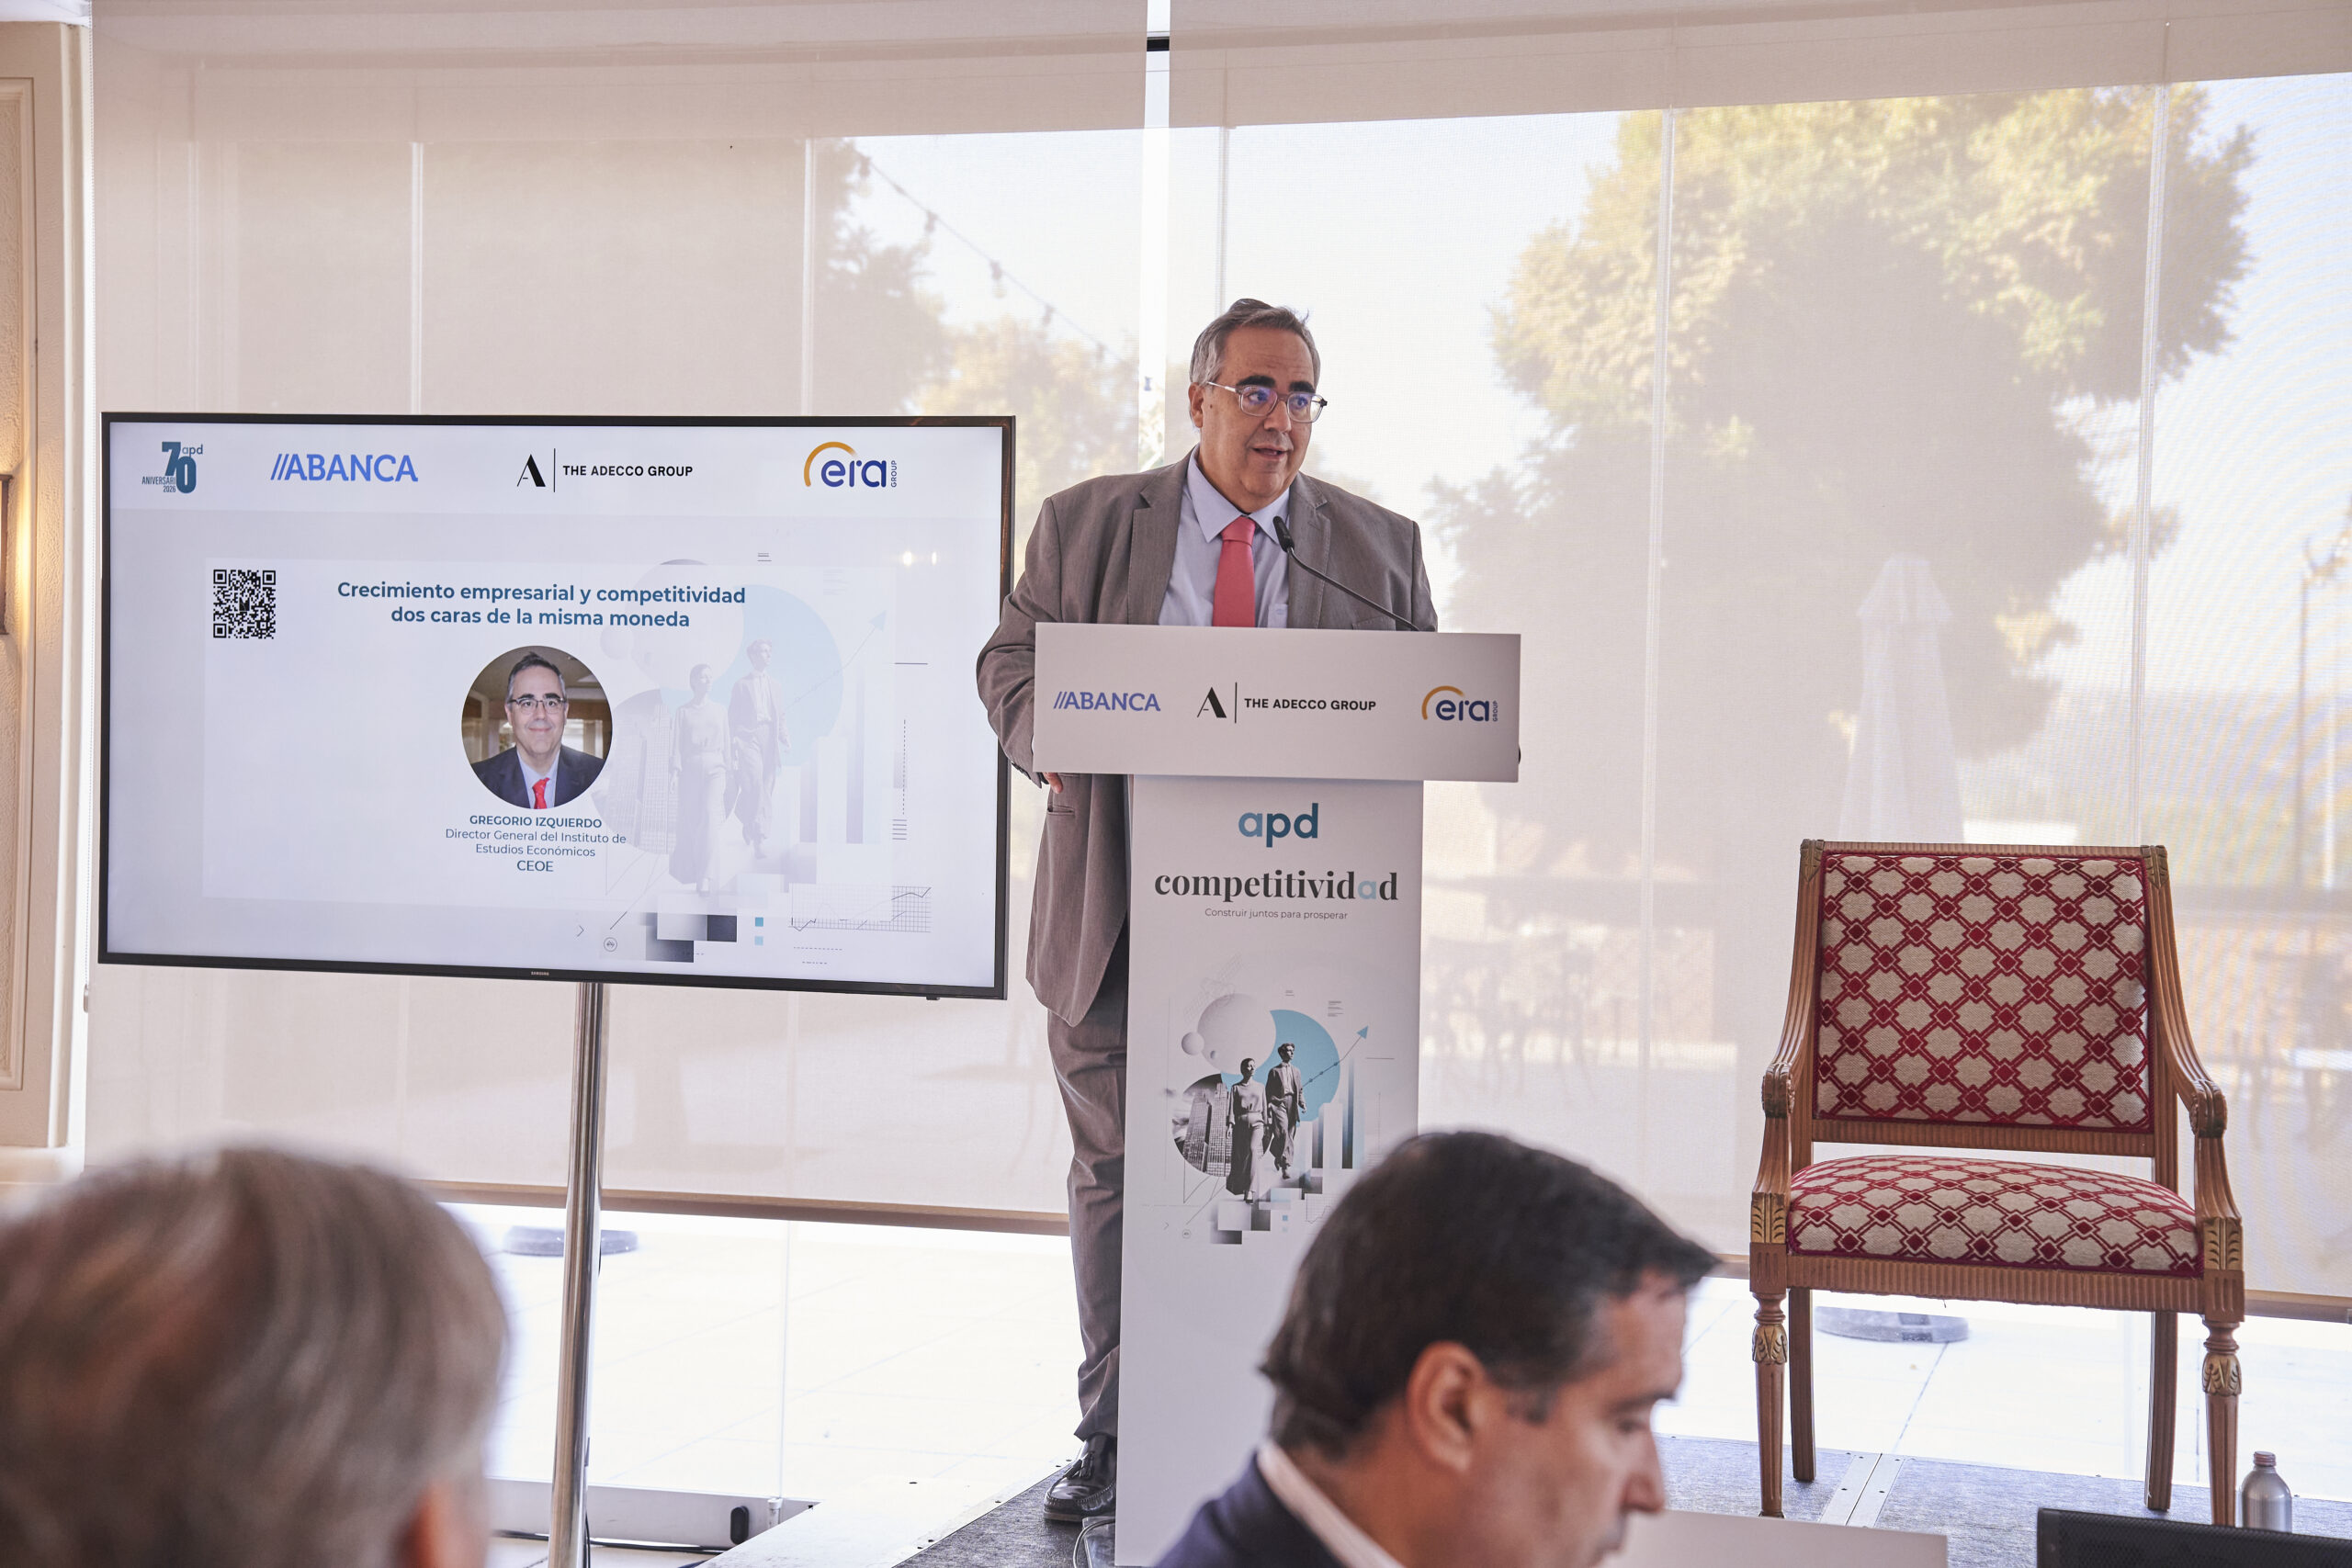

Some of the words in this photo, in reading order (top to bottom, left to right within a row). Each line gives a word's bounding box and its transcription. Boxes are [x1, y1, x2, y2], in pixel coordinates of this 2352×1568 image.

[182, 444, 203, 457] apd
[562, 465, 587, 476] THE
[590, 465, 644, 477] ADECCO
[647, 466, 694, 477] GROUP
[821, 459, 887, 488] era
[338, 581, 455, 598] Crecimiento
[460, 584, 573, 603] empresarial
[580, 590, 591, 604] y
[597, 586, 745, 605] competitividad
[391, 606, 424, 622] dos
[430, 610, 481, 624] caras
[487, 608, 510, 623] de
[517, 608, 532, 624] la
[539, 609, 603, 625] misma
[610, 611, 689, 626] moneda
[1244, 697, 1269, 709] THE
[1272, 698, 1328, 710] ADECCO
[1330, 700, 1376, 711] GROUP
[1435, 700, 1489, 721] era
[469, 815, 533, 827] GREGORIO
[535, 817, 603, 829] IZQUIERDO
[1238, 803, 1318, 848] apd
[446, 828, 491, 840] Director
[493, 829, 537, 841] General
[540, 831, 558, 841] del
[560, 832, 609, 843] Instituto
[612, 833, 627, 844] de
[476, 843, 524, 855] Estudios
[526, 845, 596, 857] Económicos
[516, 860, 554, 873] CEOE
[1155, 870, 1398, 902] competitividad
[1204, 908, 1248, 918] Construir
[1248, 908, 1279, 919] juntos
[1280, 911, 1302, 919] para
[1303, 911, 1348, 921] prosperar
